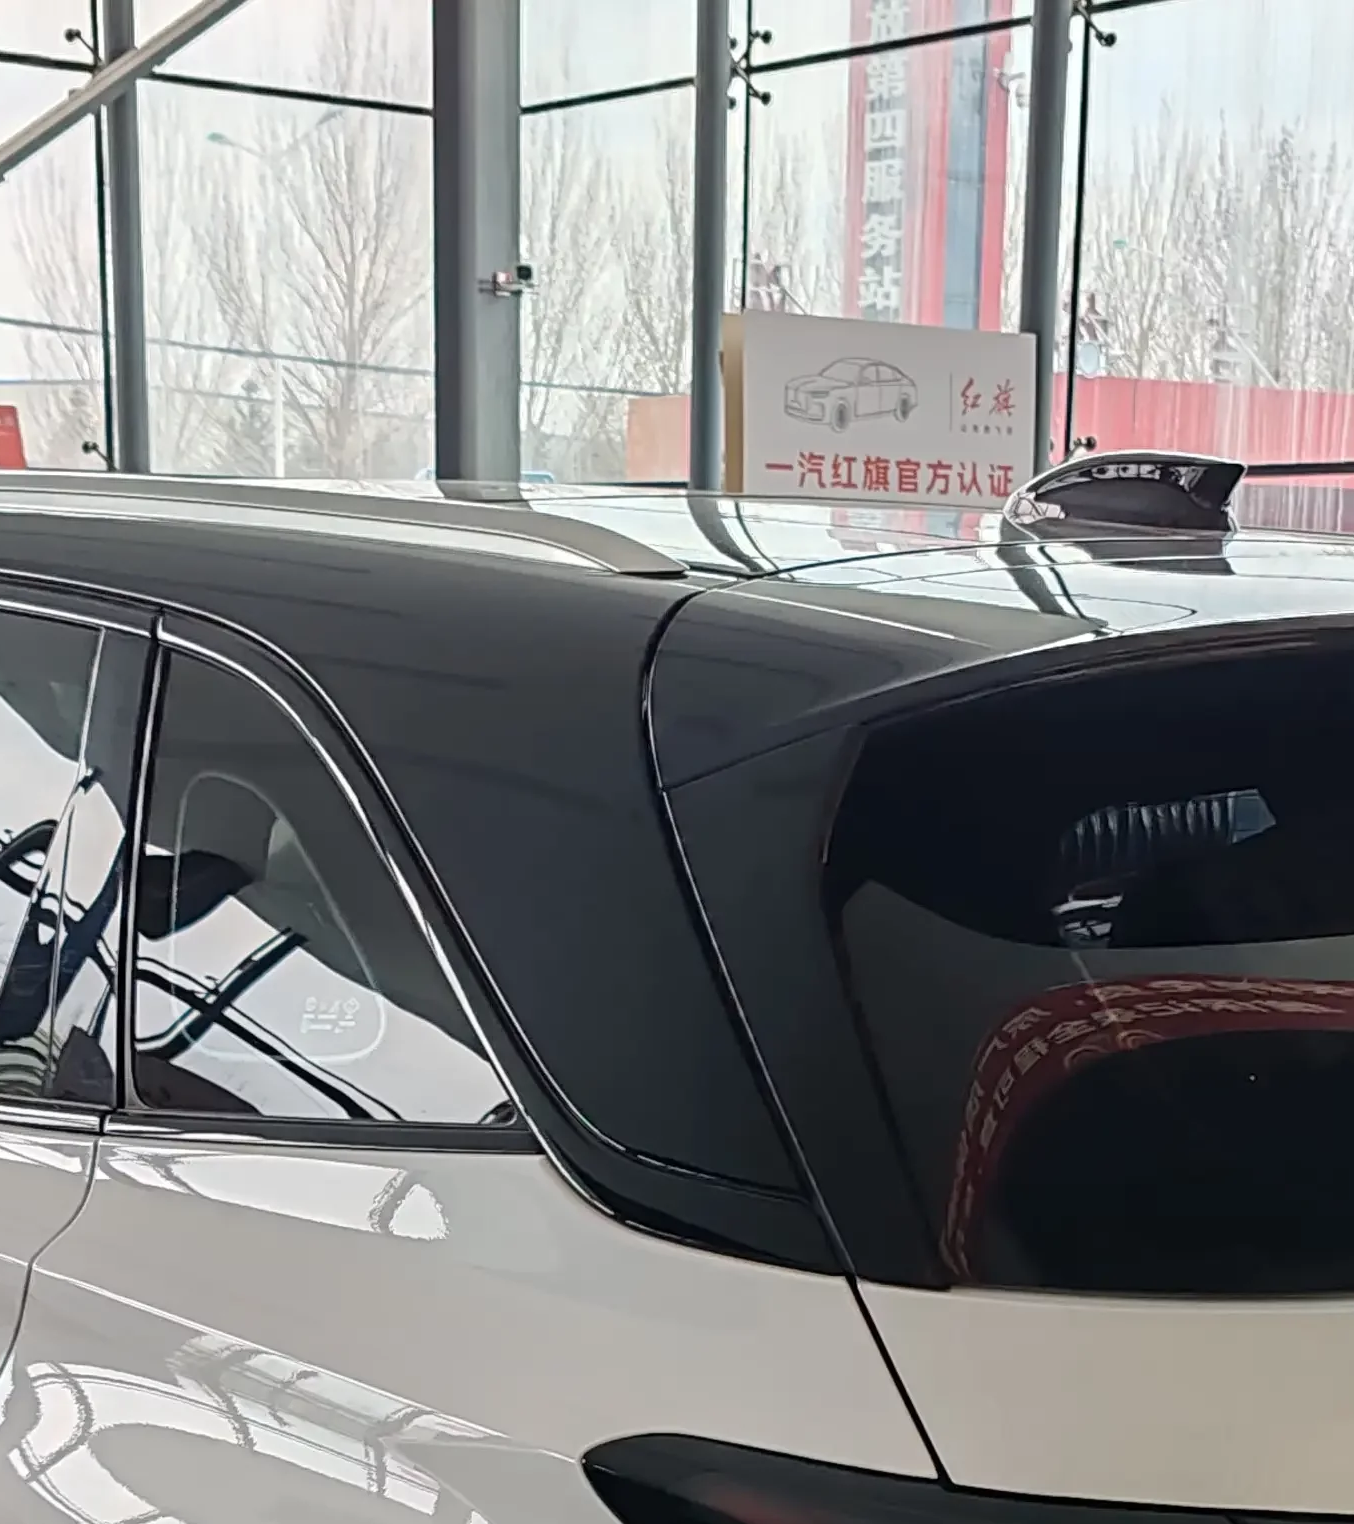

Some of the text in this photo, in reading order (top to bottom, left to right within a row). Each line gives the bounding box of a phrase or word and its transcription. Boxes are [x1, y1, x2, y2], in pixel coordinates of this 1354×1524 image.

[960, 377, 1016, 416] 红旗
[765, 451, 1014, 498] 一汽红旗官方认证
